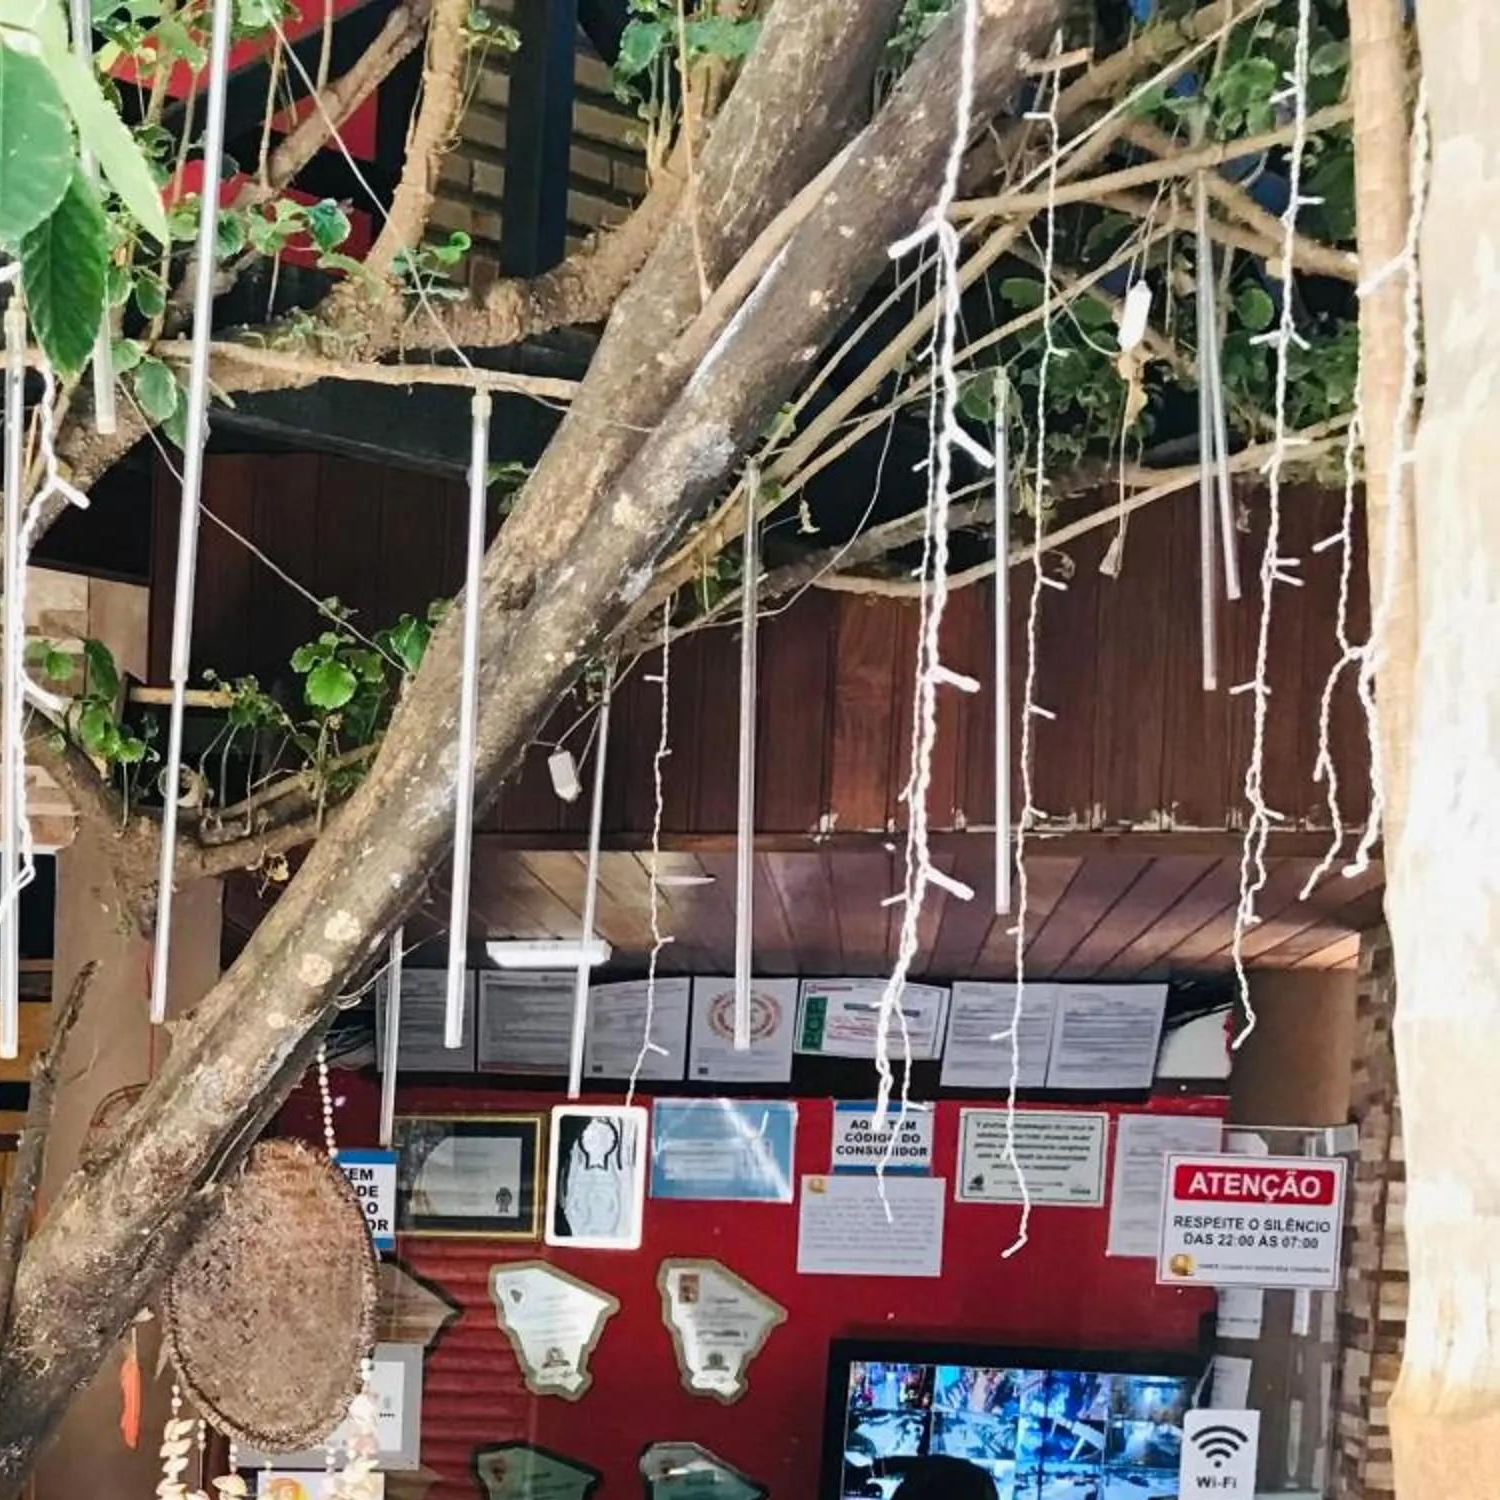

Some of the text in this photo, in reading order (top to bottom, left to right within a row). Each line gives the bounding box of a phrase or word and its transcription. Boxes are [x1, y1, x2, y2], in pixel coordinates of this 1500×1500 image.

[850, 1119, 884, 1131] AQ
[901, 1133, 921, 1144] DO
[345, 1167, 373, 1181] EM
[1188, 1171, 1321, 1203] ATENÇÃO
[1173, 1215, 1331, 1233] RESPEITE O SILÊNCIO
[1183, 1233, 1213, 1246] DAS
[1217, 1234, 1255, 1247] 22:00
[1281, 1236, 1319, 1250] 07:00
[1196, 1476, 1237, 1489] Wi-Fi
